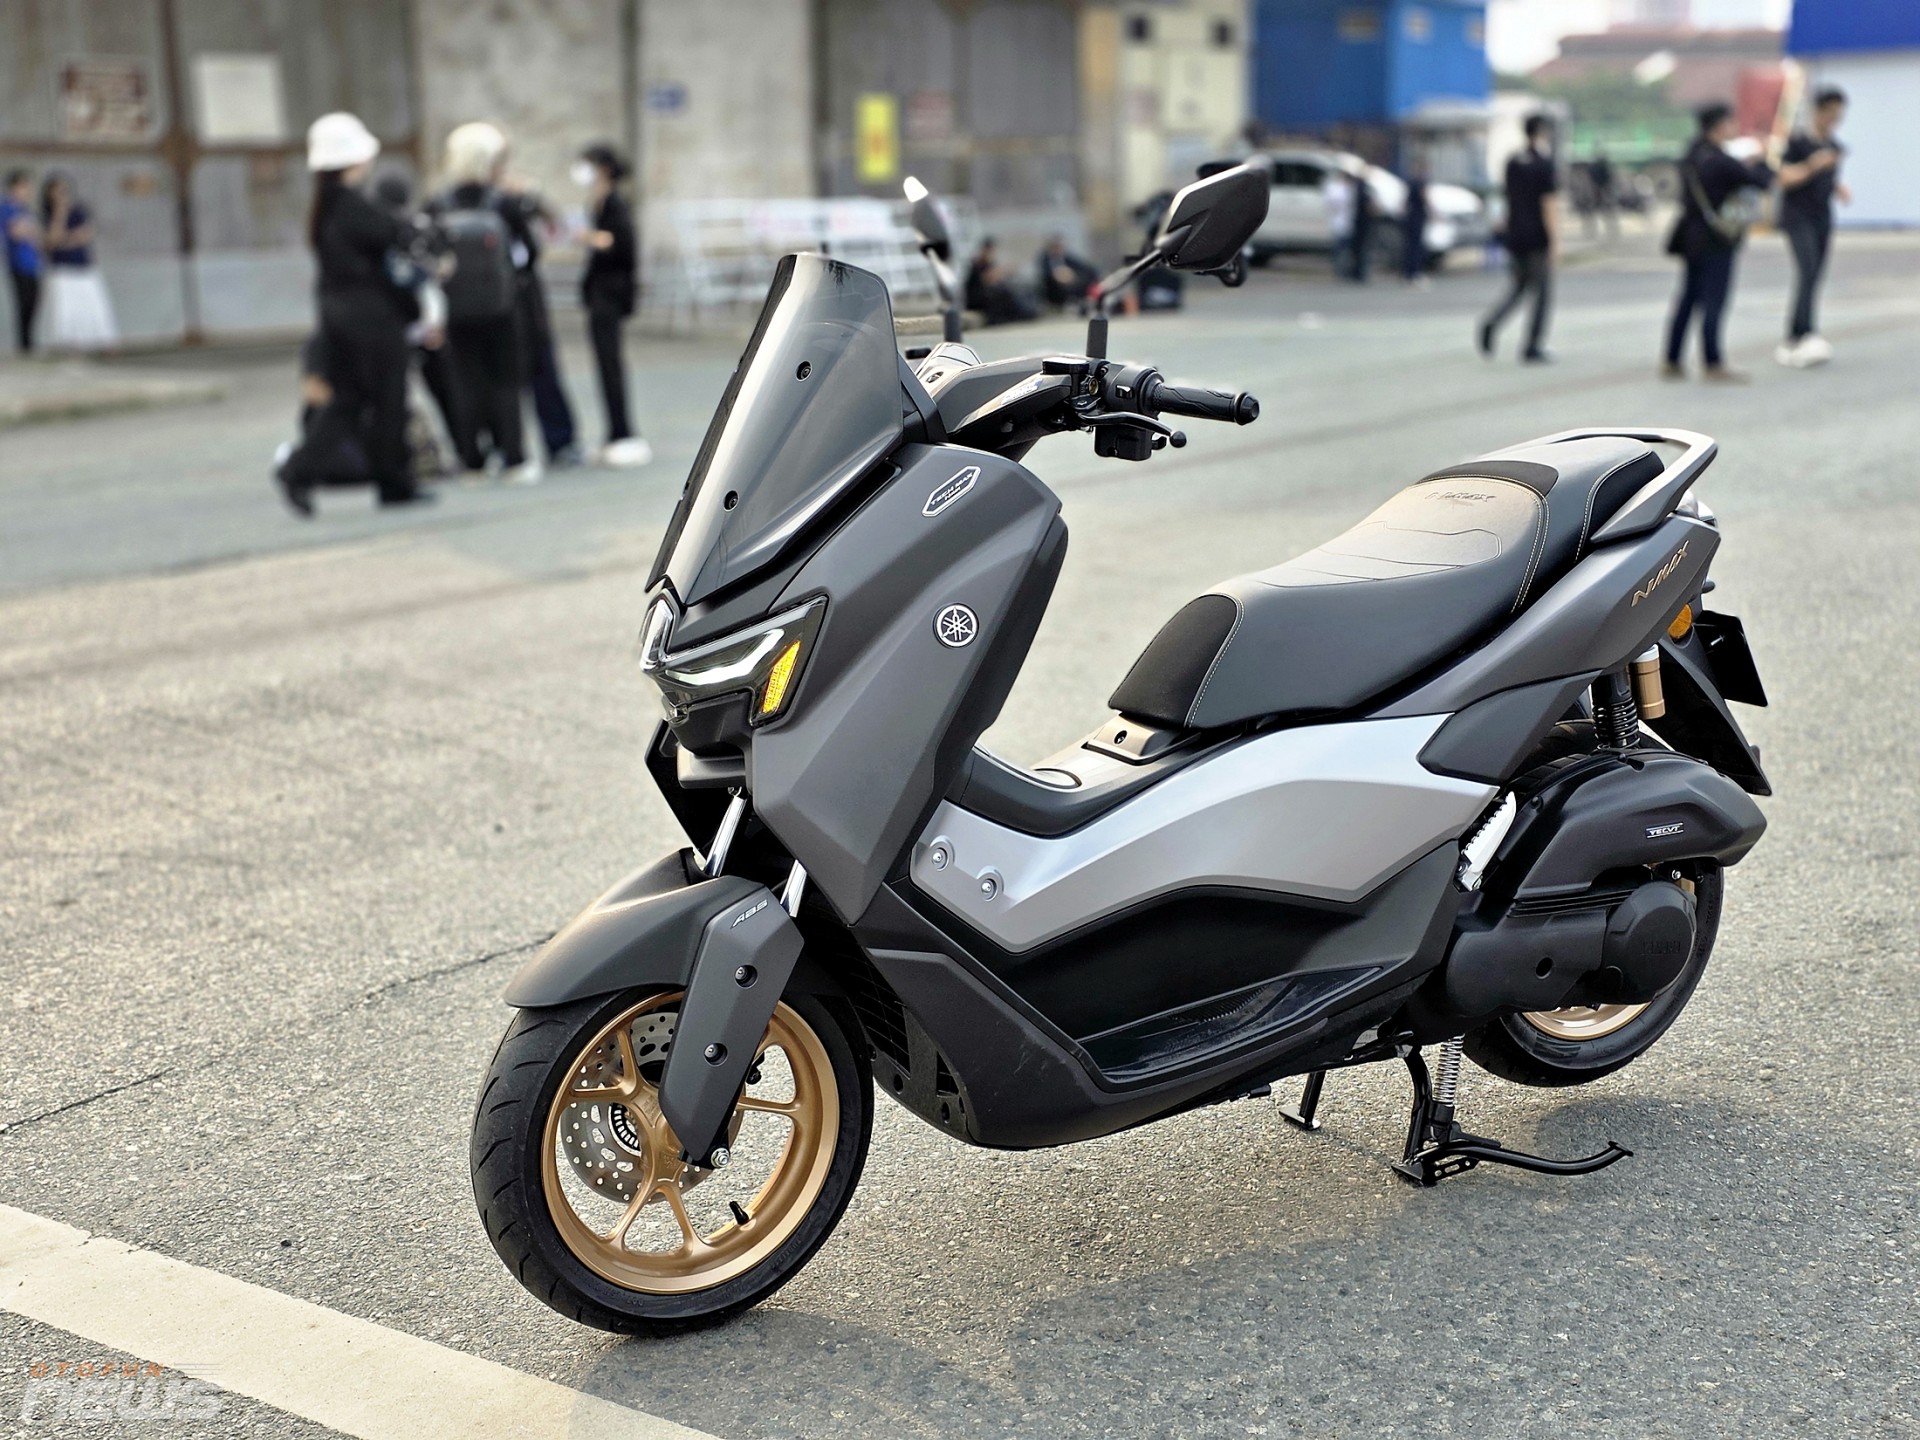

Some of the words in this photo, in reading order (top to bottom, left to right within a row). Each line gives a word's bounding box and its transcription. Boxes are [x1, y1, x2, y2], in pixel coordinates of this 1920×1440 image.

[955, 472, 973, 488] MAX
[1631, 540, 1689, 607] NMAX
[1649, 825, 1681, 836] YECVT
[730, 899, 768, 929] ABS
